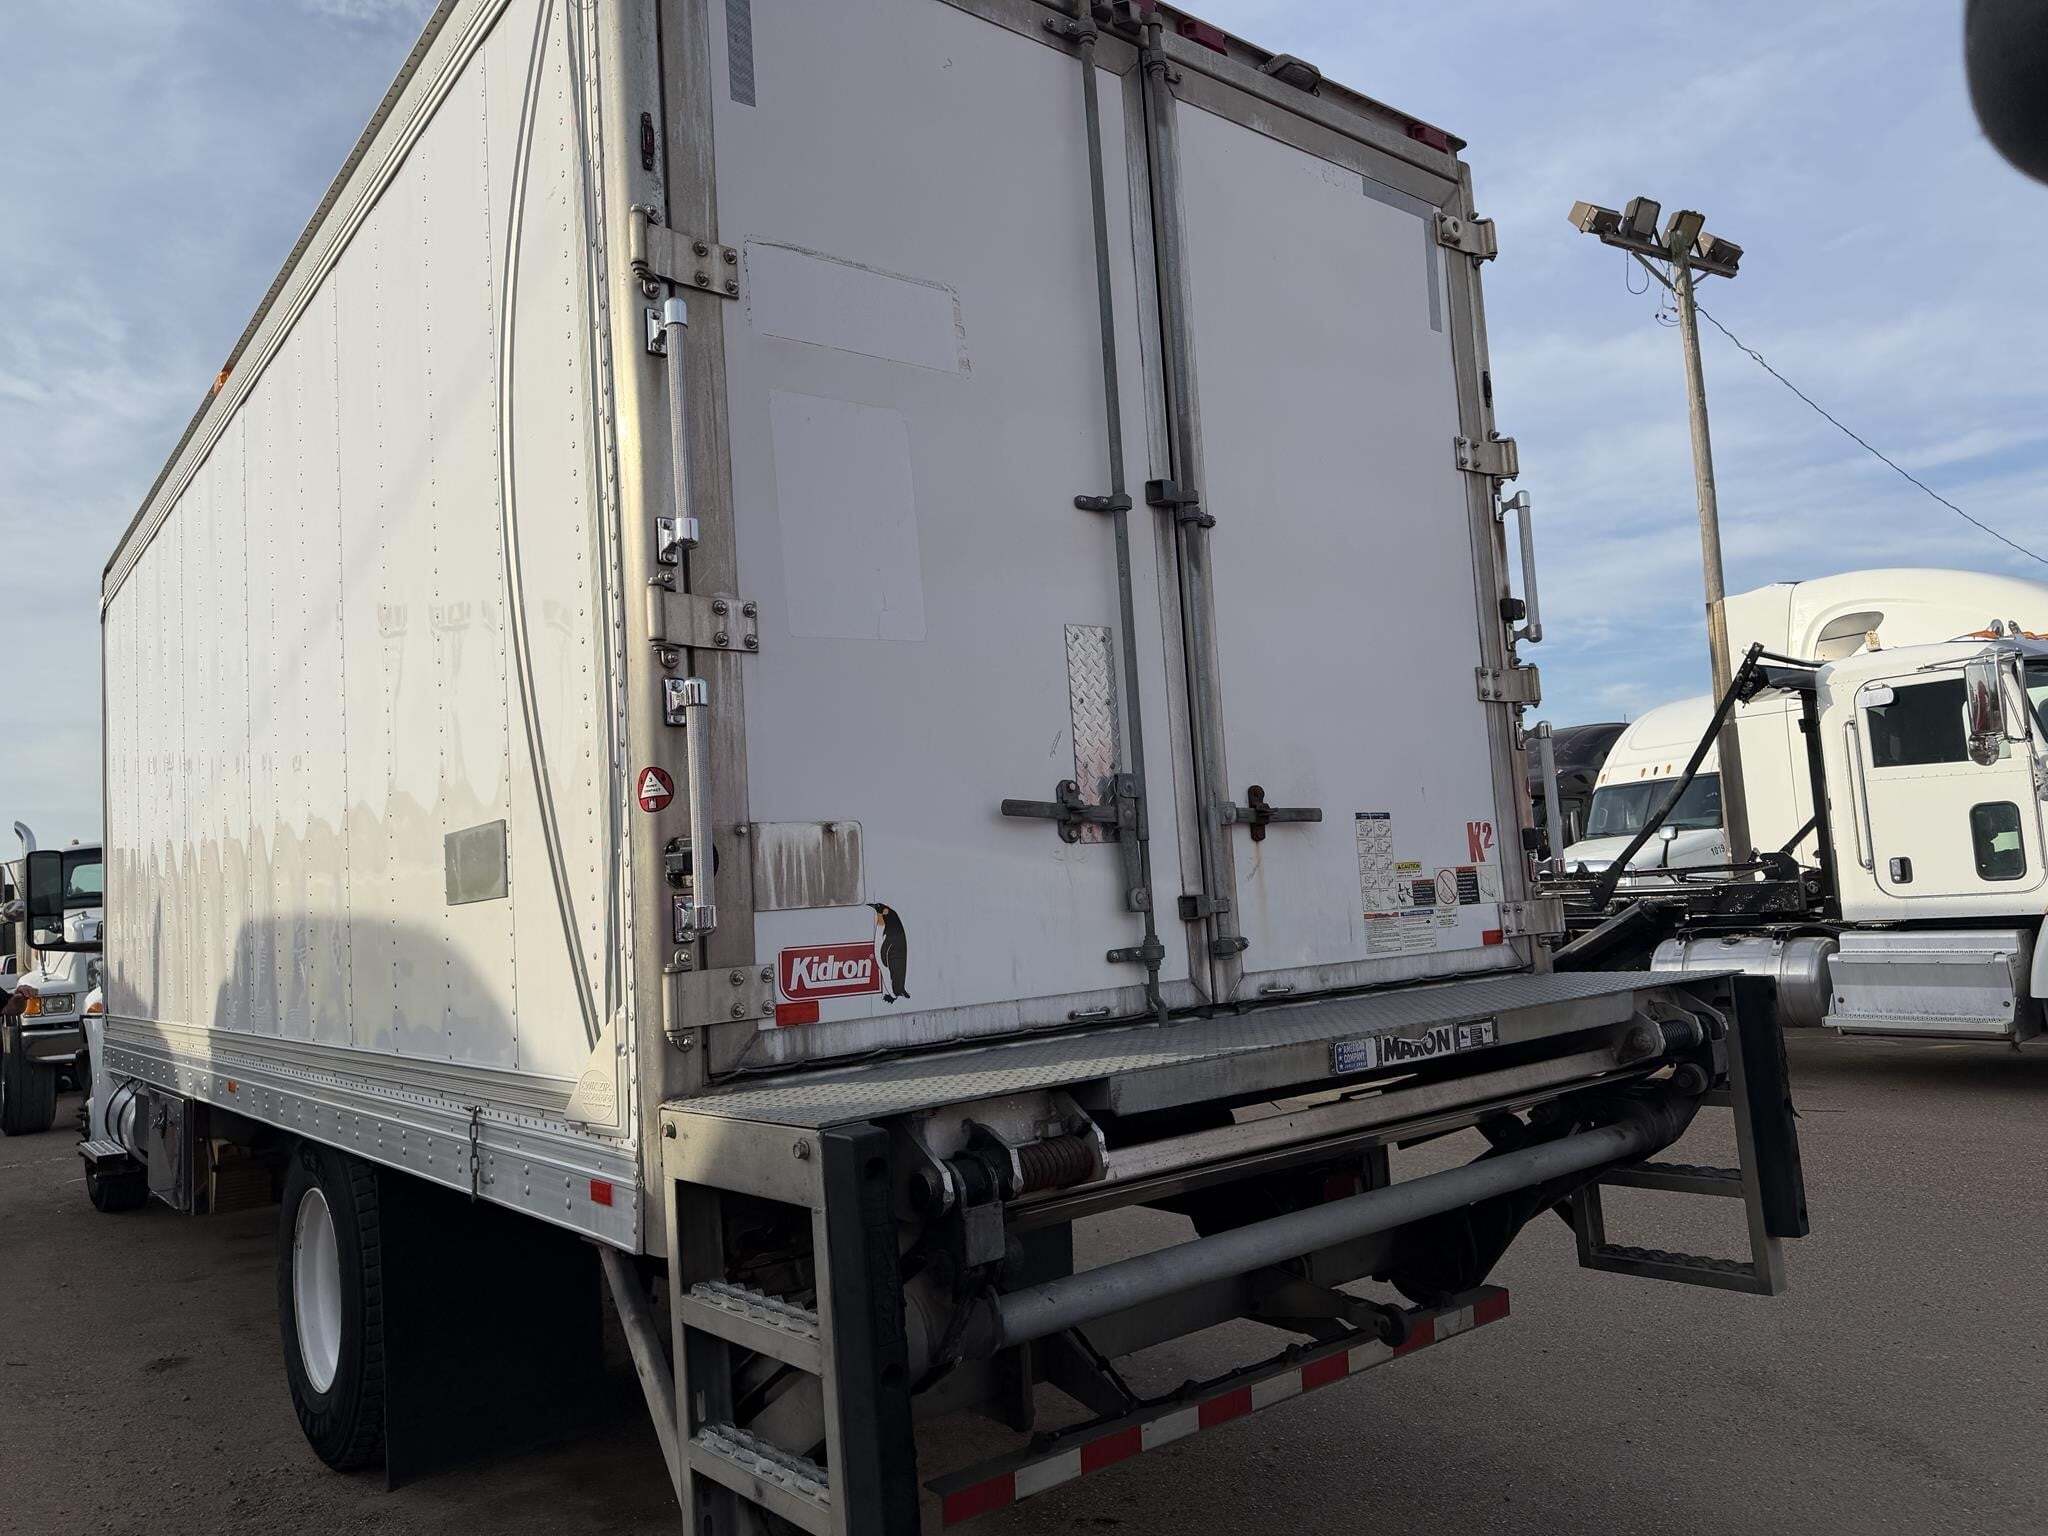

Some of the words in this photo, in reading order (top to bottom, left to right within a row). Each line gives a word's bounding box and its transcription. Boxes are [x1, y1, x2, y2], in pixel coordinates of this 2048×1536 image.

[1467, 821, 1494, 862] K2
[1711, 844, 1725, 856] 1019
[789, 955, 871, 991] Kidron
[1384, 1028, 1451, 1062] MAXON
